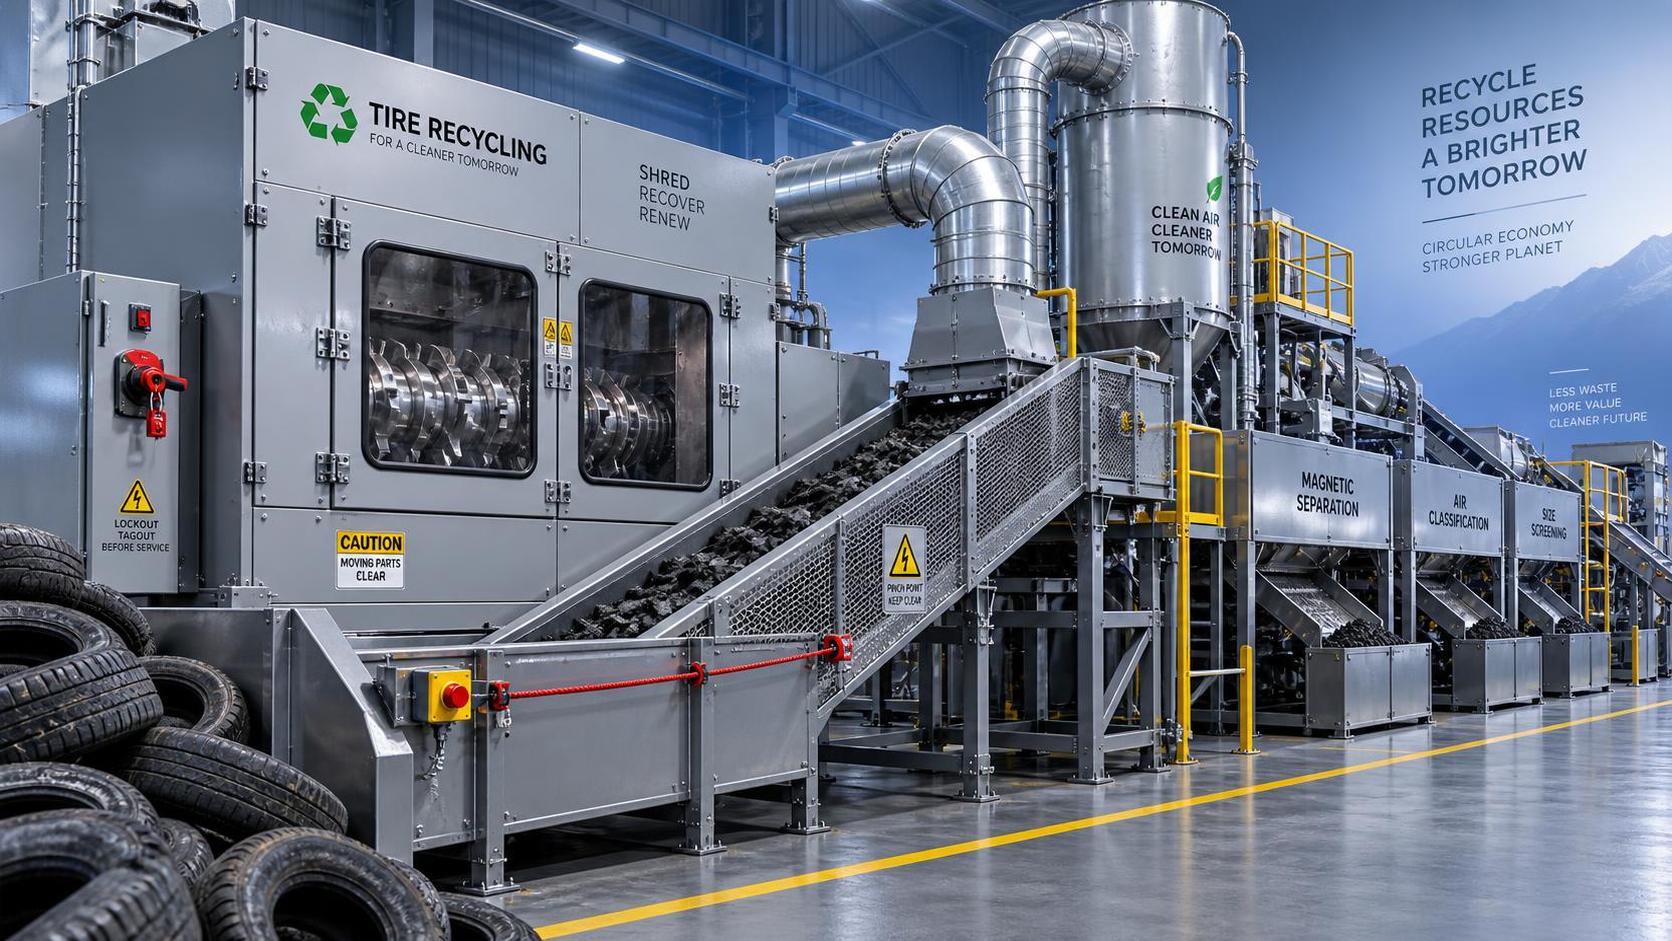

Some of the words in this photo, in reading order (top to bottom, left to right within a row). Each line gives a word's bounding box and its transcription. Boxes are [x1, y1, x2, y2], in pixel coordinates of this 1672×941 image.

[1422, 63, 1537, 107] RECYCLE
[1422, 85, 1584, 138] RESOURCES
[369, 101, 421, 135] TIRE
[428, 116, 547, 165] RECYCLING
[1421, 148, 1438, 169] A
[1447, 118, 1580, 164] BRIGHTER
[369, 133, 392, 148] FOR
[395, 139, 404, 151] A
[407, 141, 455, 162] CLEANER
[457, 153, 519, 177] TOMORROW
[639, 164, 690, 191] SHRED
[1421, 148, 1587, 199] TOMORROW
[639, 185, 705, 215] RECOVER
[639, 206, 691, 231] RENEW
[1151, 205, 1199, 221] CLEAN
[1203, 211, 1220, 228] AIR
[1151, 223, 1213, 242] CLEANER
[1422, 232, 1493, 255] CIRCULAR
[1498, 219, 1574, 243] ECONOMY
[1151, 241, 1222, 261] TOMORROW
[1422, 251, 1501, 273] STRONGER
[1506, 240, 1563, 261] PLANET
[1549, 387, 1576, 398] LESS
[1579, 382, 1618, 395] WASTE
[1549, 401, 1581, 413] MORE
[1585, 397, 1622, 410] VALUE
[1549, 415, 1600, 428] CLEANER
[1603, 411, 1648, 424] FUTURE
[1301, 471, 1354, 495] MAGNETIC
[1297, 494, 1359, 517] SEPARATION
[1453, 494, 1467, 510] AIR
[114, 519, 160, 529] LOCKOUT
[1428, 510, 1489, 531] CLASSIFICATION
[1531, 523, 1567, 540] SCREENING
[118, 531, 156, 540] TAGOUT
[340, 534, 402, 551] CAUTION
[101, 542, 134, 552] BEFORE
[136, 543, 170, 552] SERVICE
[340, 557, 374, 568] MOVING
[375, 558, 401, 568] PARTS
[356, 570, 386, 581] CLEAR
